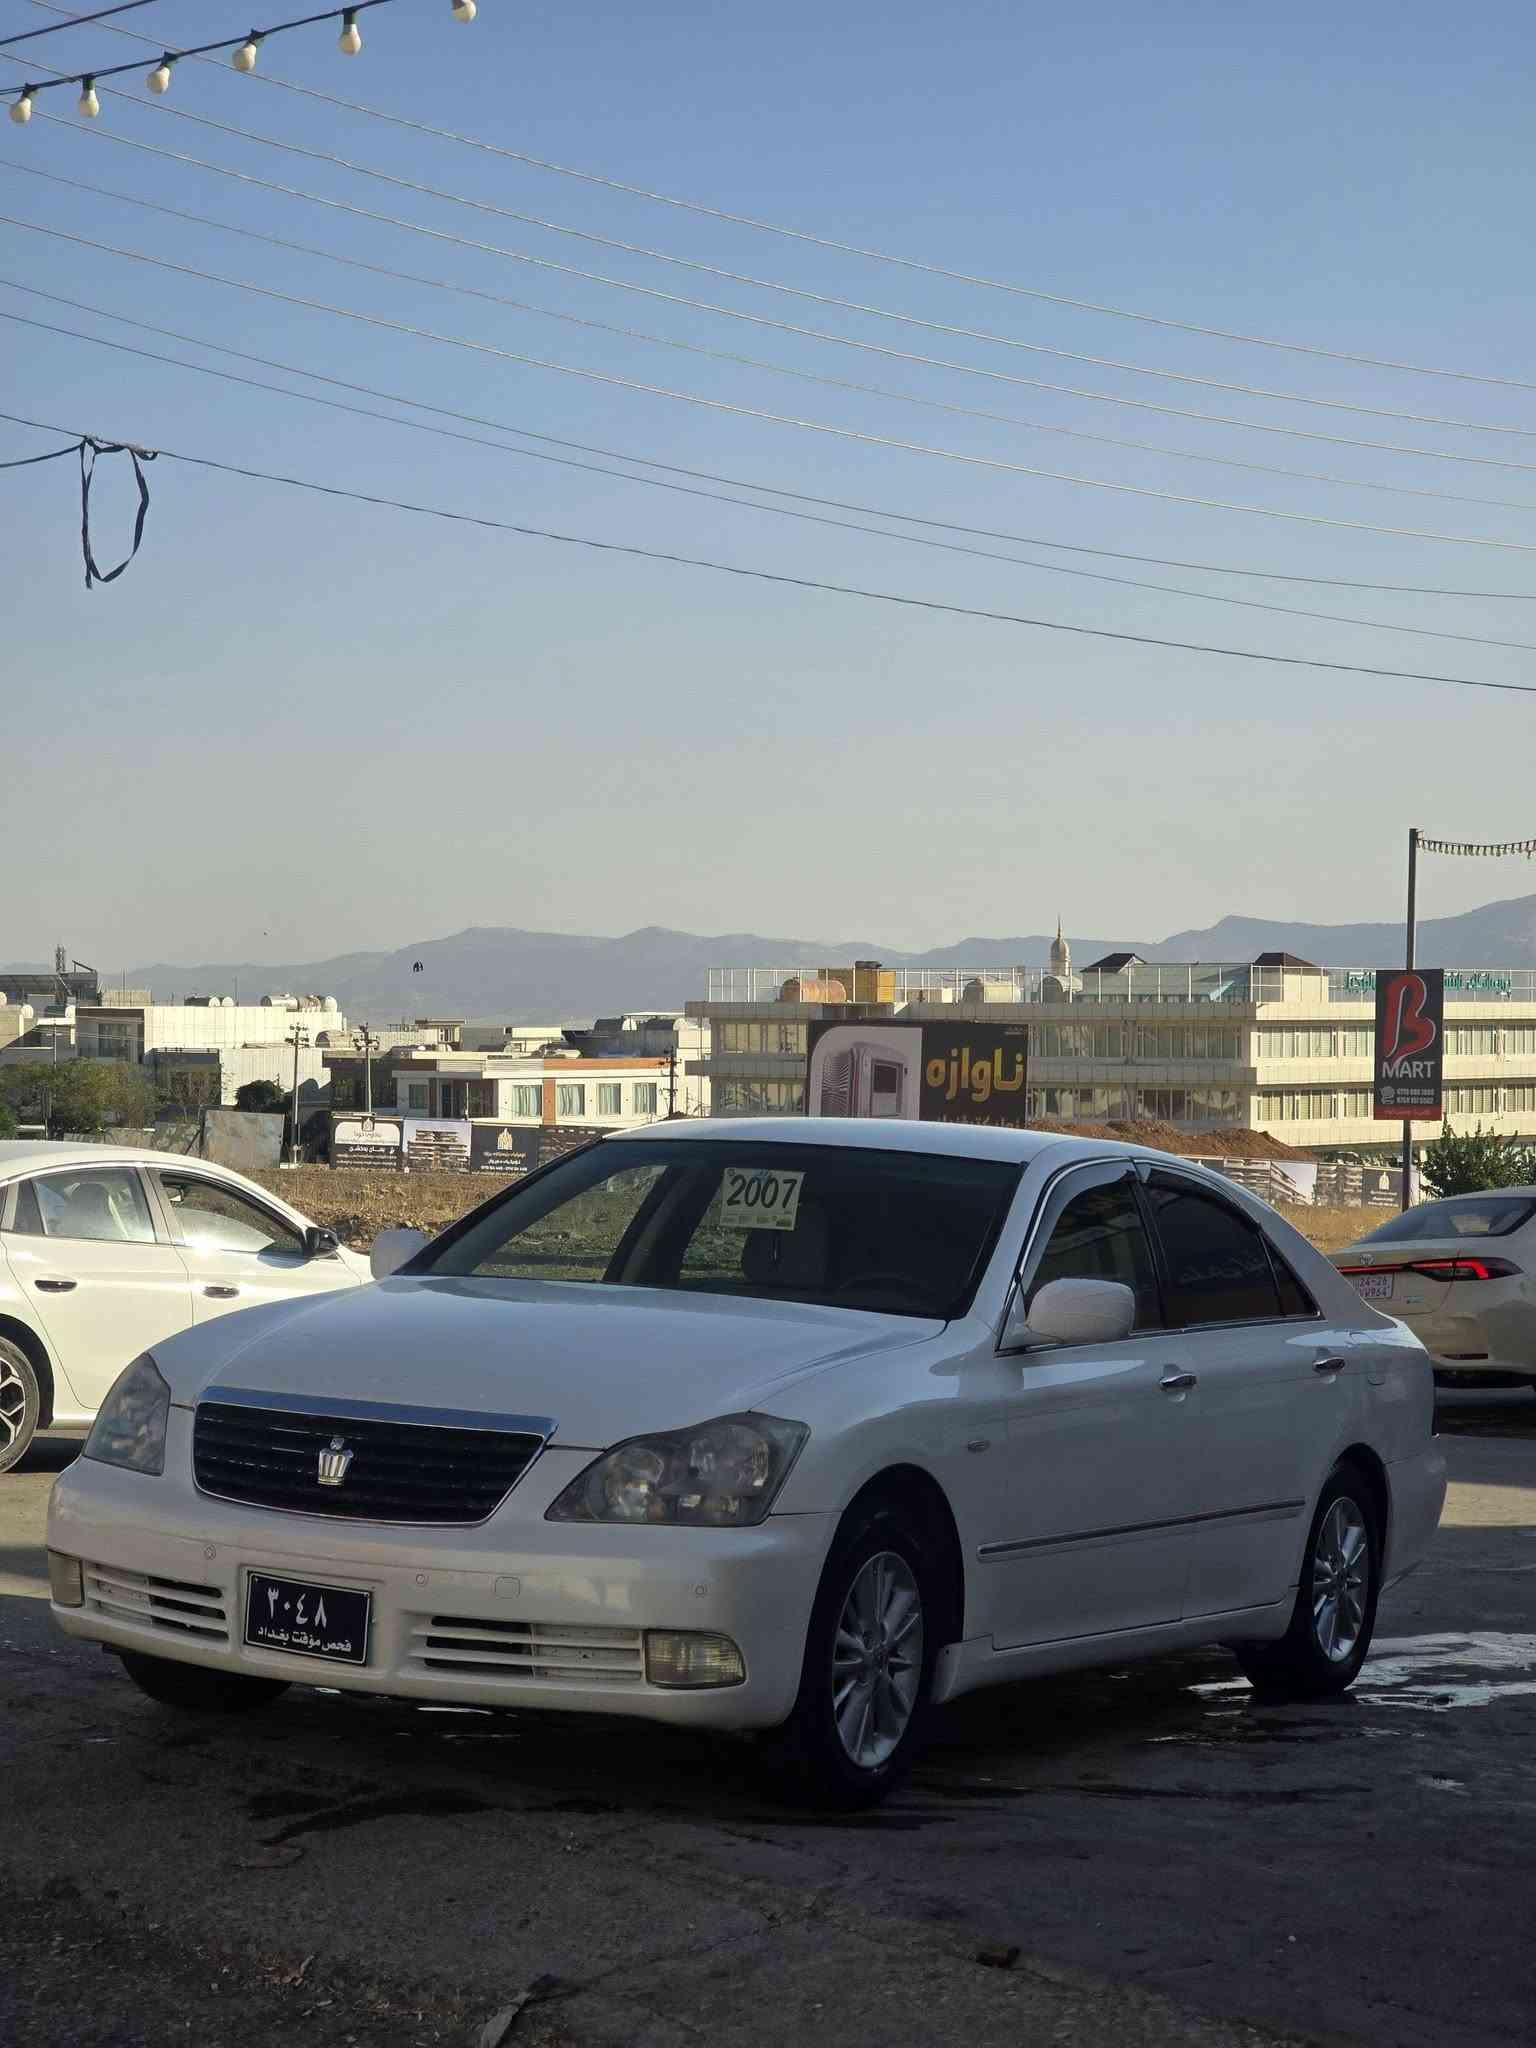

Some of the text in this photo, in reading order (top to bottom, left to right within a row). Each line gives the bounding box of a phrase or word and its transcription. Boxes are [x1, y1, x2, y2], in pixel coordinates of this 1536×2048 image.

[1382, 1061, 1436, 1078] MART
[726, 1174, 798, 1208] 2007
[267, 1587, 328, 1629] ٣٠٤٨
[257, 1626, 352, 1653] فحص مؤقت بغداد
